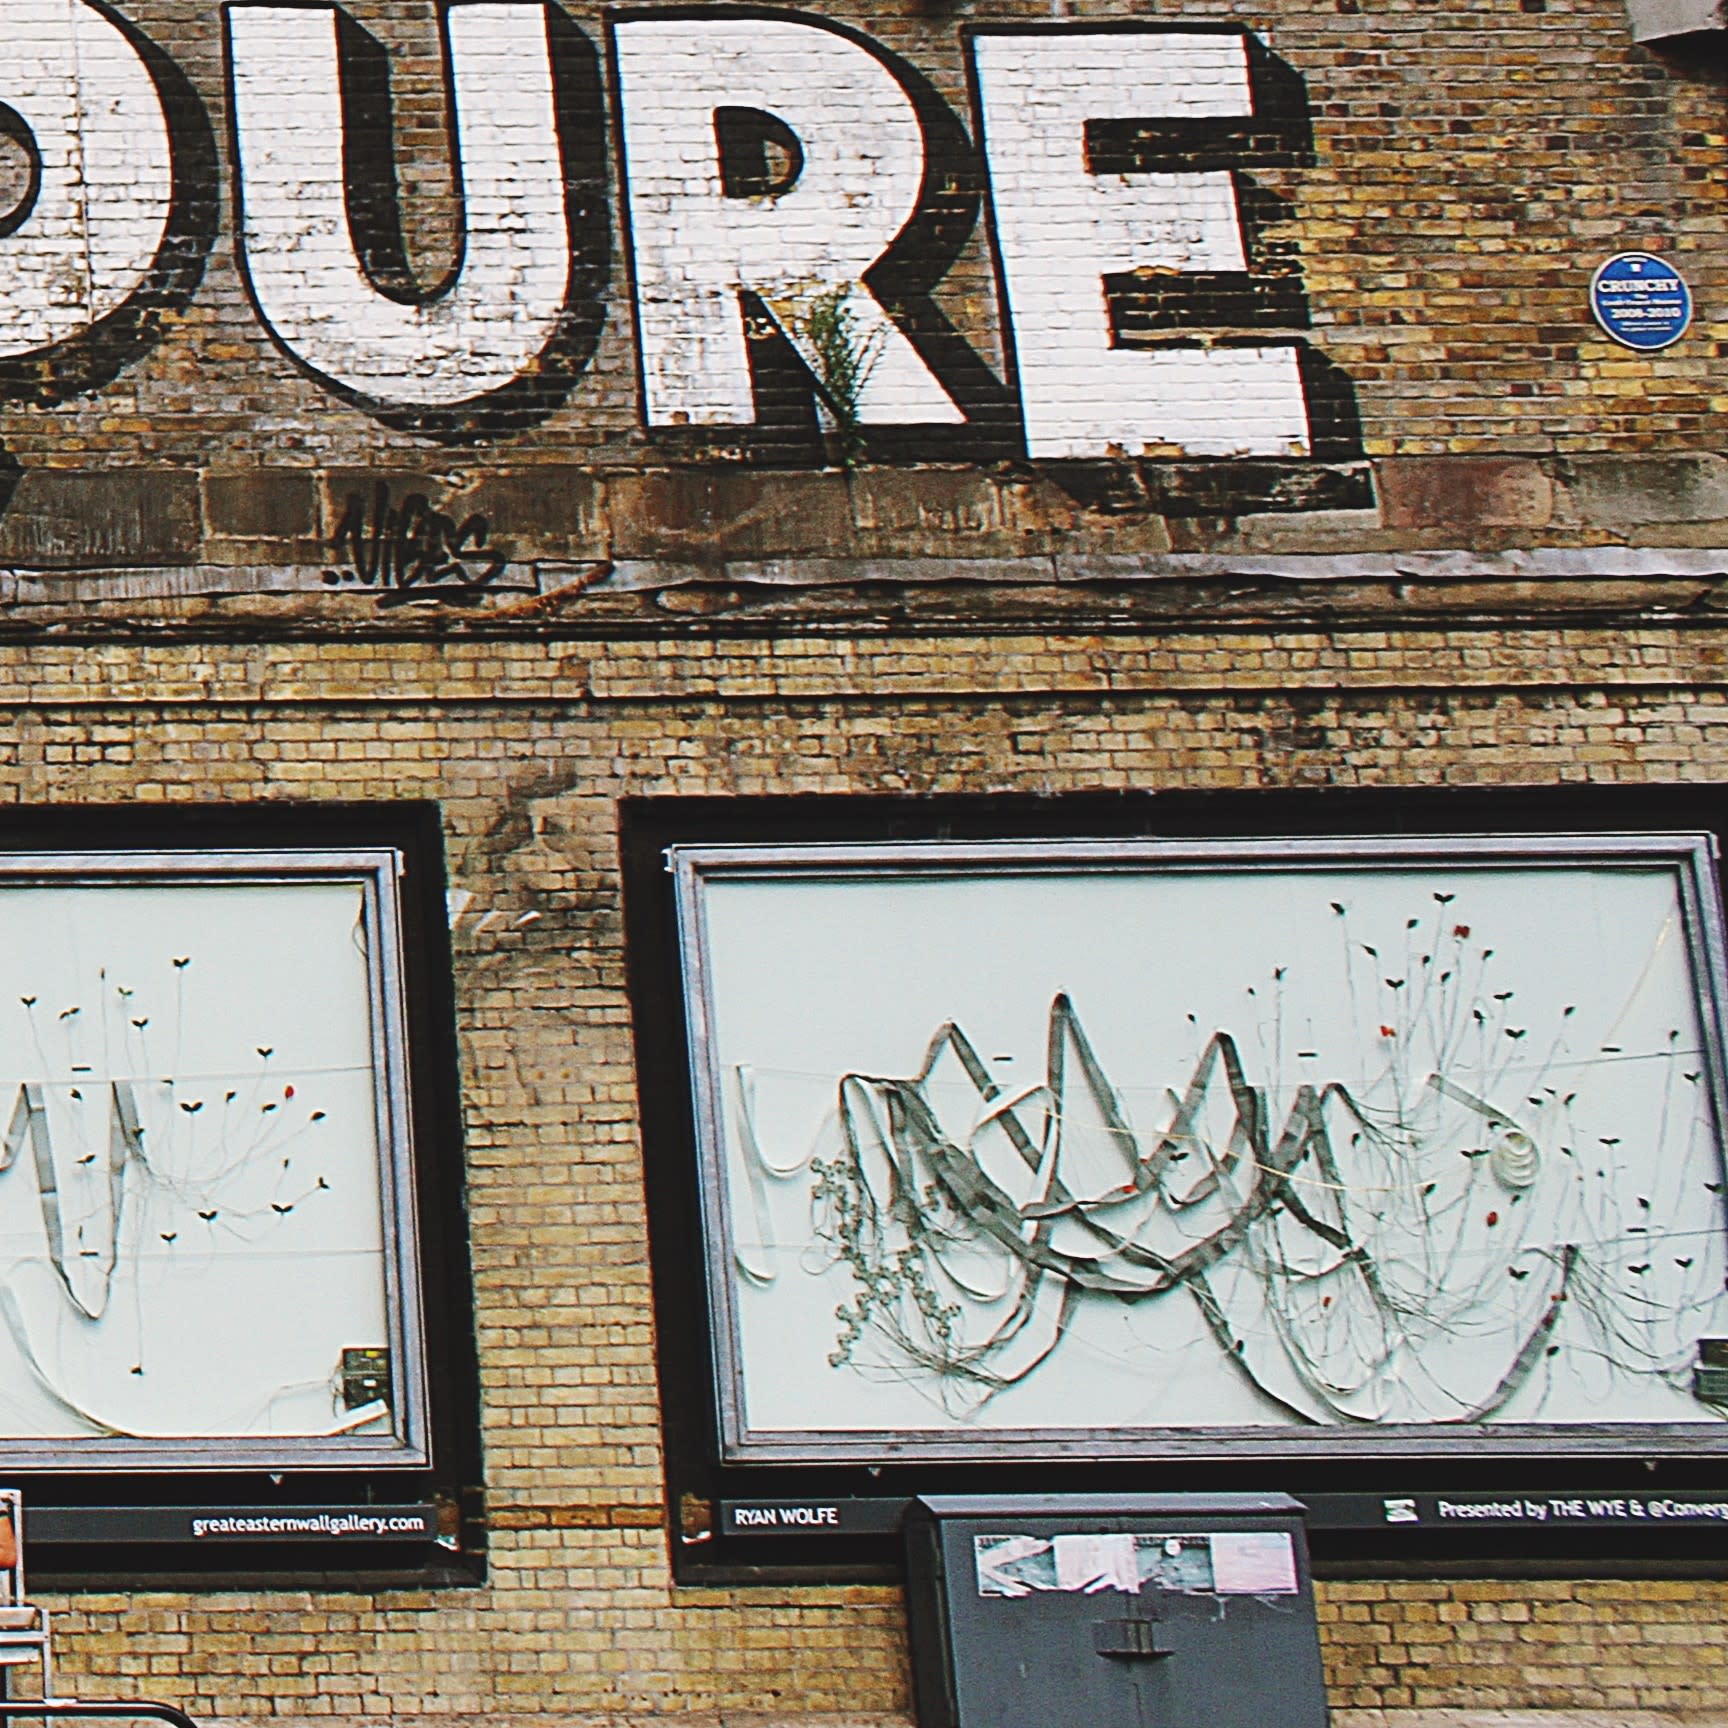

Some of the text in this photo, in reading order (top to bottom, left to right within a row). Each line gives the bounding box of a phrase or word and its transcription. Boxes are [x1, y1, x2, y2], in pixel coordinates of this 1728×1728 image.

[735, 1507, 838, 1525] RYAN WOLFE
[1438, 1500, 1523, 1519] Presented
[1525, 1500, 1546, 1520] by
[1549, 1499, 1585, 1516] THE
[1587, 1499, 1626, 1516] WYE
[1630, 1499, 1647, 1518] &
[193, 1514, 425, 1535] greateasternwallgallery.com
